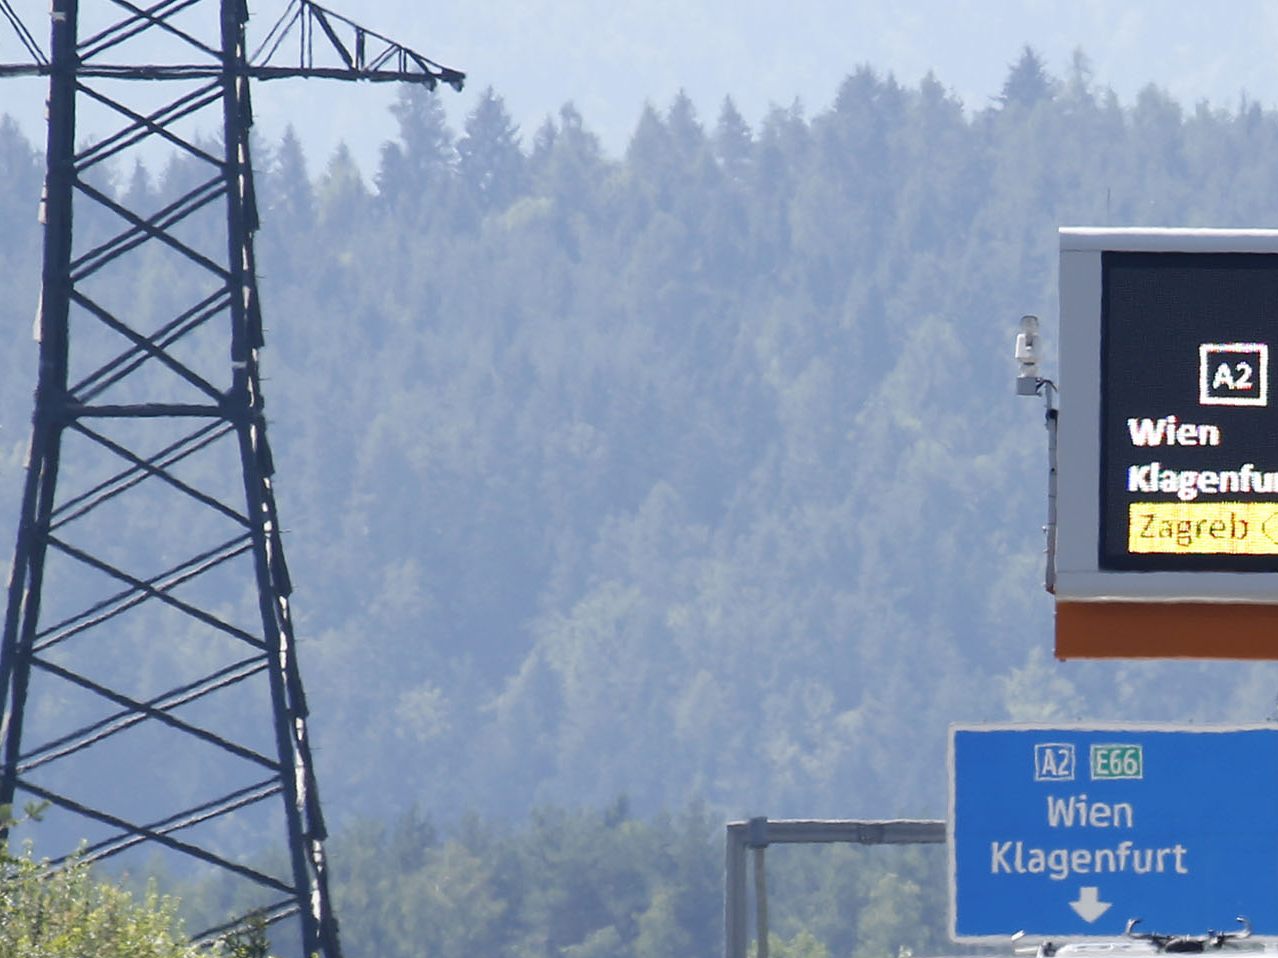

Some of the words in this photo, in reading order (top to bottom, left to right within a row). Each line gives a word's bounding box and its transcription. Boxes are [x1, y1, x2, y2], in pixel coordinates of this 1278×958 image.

[1212, 361, 1254, 390] A2
[1127, 415, 1222, 447] Wien
[1139, 512, 1249, 546] Zagreb
[1042, 748, 1070, 776] A2
[1096, 748, 1139, 776] E66
[1046, 794, 1133, 828] Wien
[990, 841, 1188, 880] Klagenfurt
